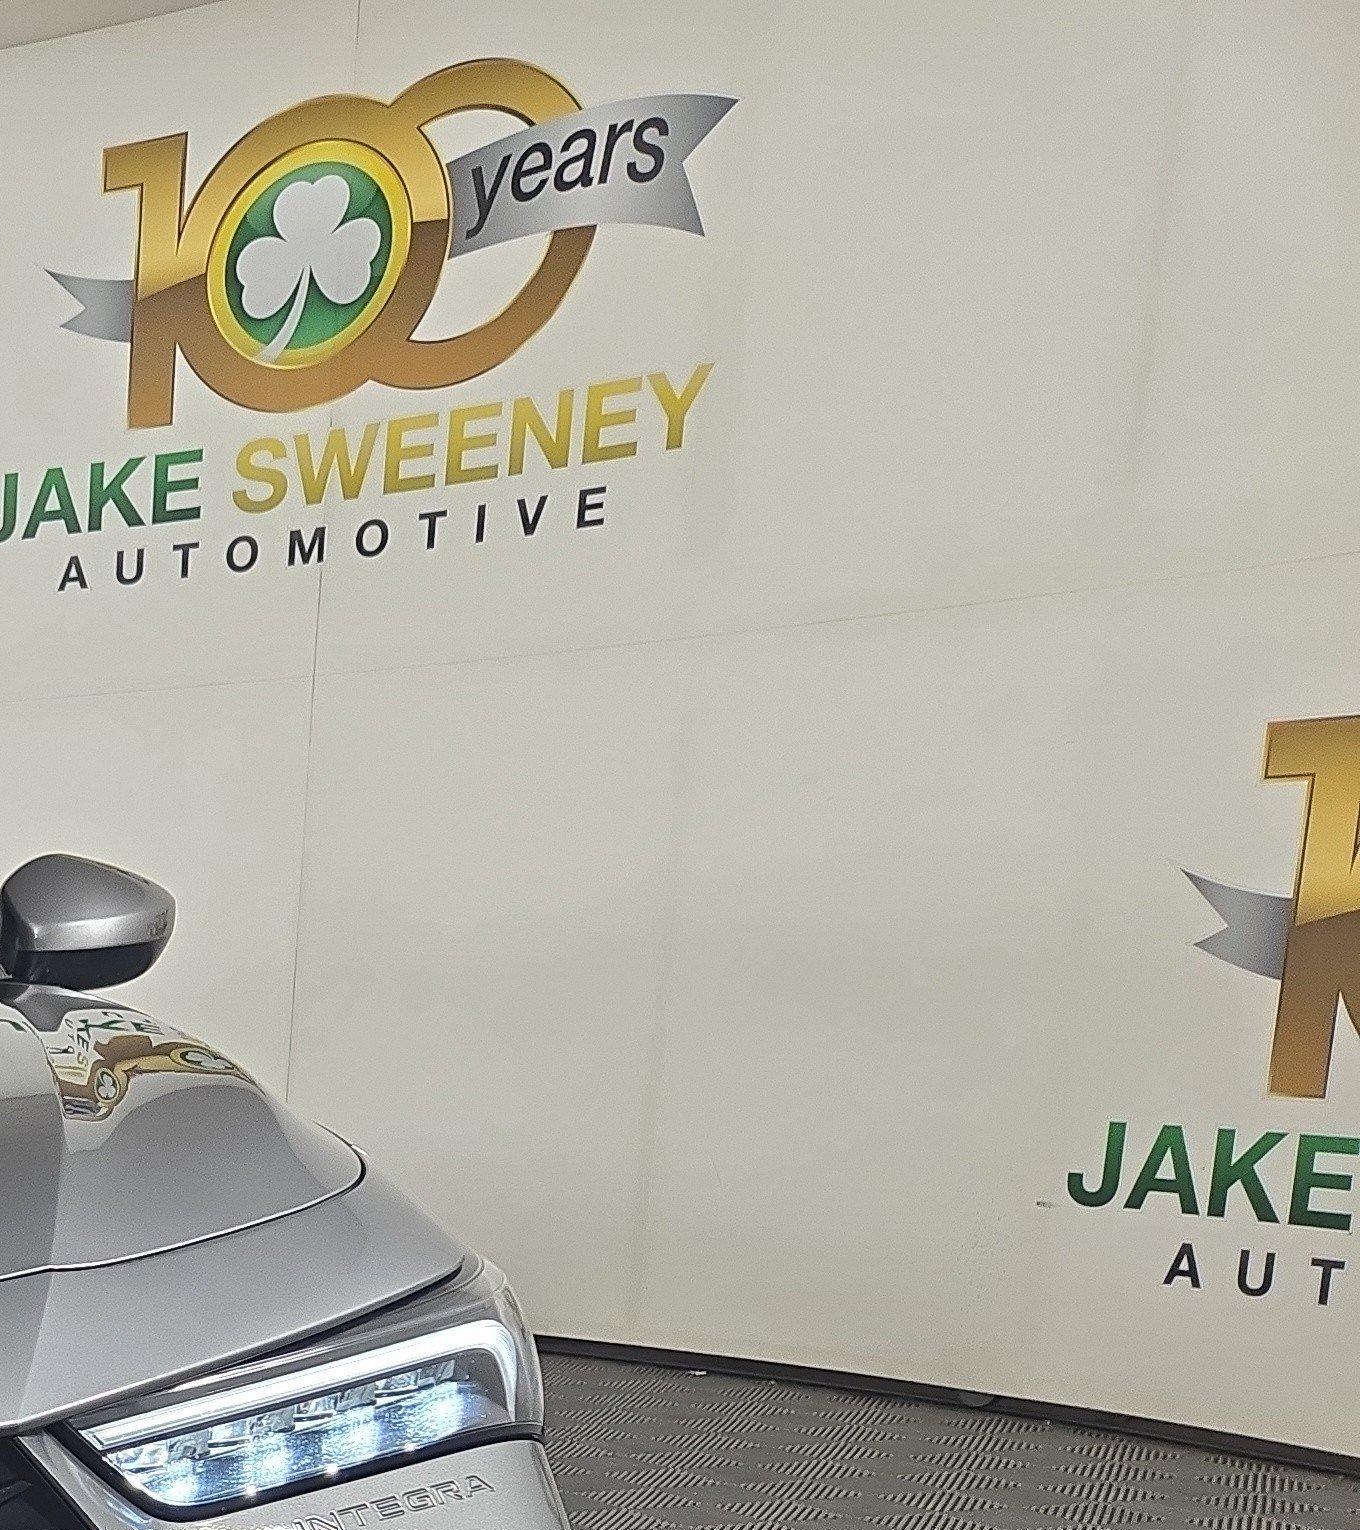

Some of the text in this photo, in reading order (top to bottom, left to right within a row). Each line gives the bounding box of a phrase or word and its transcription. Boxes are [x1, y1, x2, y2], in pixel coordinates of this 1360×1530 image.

[466, 113, 671, 241] years
[231, 362, 715, 514] SWEENEY
[57, 485, 608, 593] AUTOMOTIVE
[1066, 1120, 1360, 1231] JAKE
